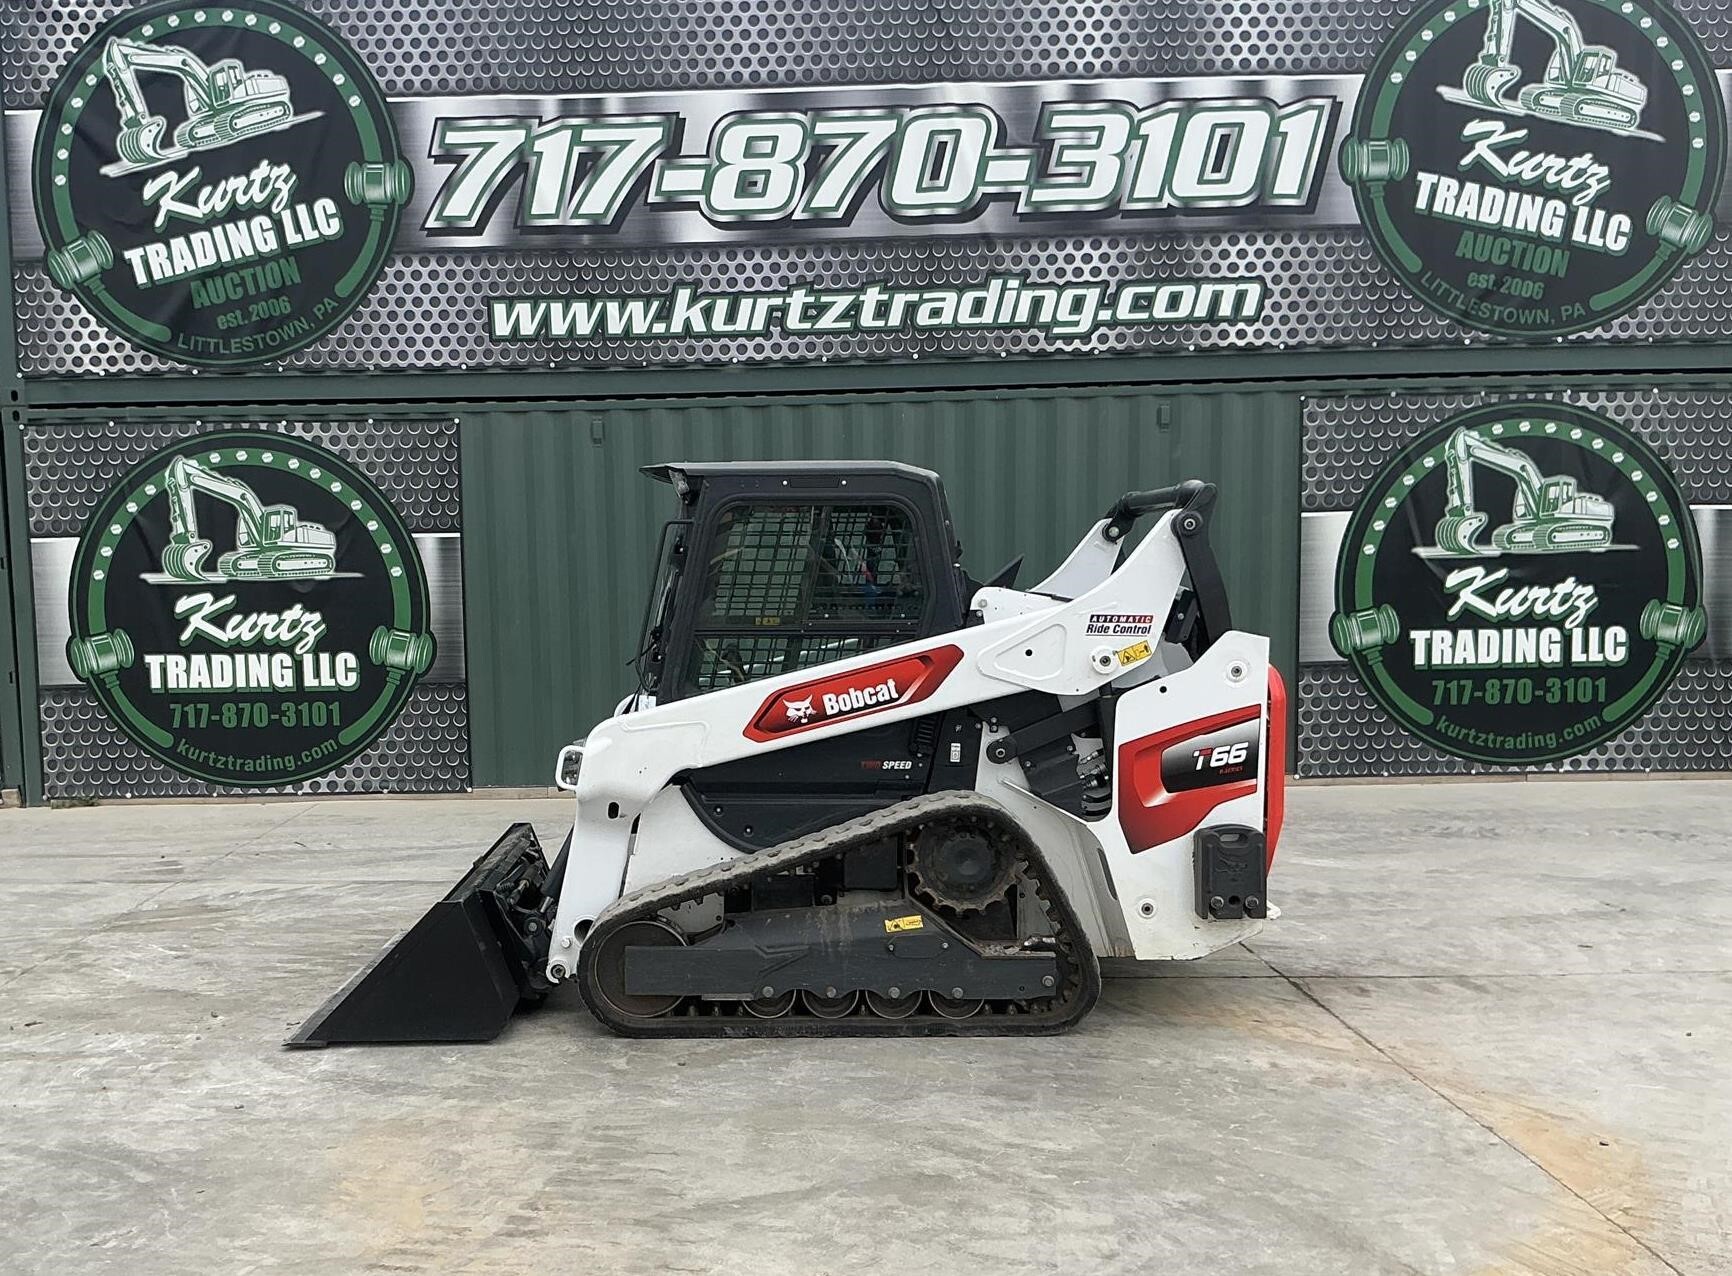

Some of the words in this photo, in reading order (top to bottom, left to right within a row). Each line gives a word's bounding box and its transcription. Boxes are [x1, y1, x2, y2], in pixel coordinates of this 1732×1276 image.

[428, 100, 1332, 230] 717-870-3101
[1458, 120, 1610, 204] Kurtz
[143, 160, 297, 230] Kurtz
[1415, 172, 1568, 240] TRADING
[1572, 206, 1633, 253] LLC
[124, 216, 275, 287] TRADING
[281, 198, 342, 246] LLC
[1455, 231, 1570, 278] AUCTION
[190, 257, 301, 309] AUCTION
[1420, 271, 1556, 325] LITTLESTOWN,
[1561, 303, 1586, 320] PA
[1467, 271, 1496, 289] est.
[1500, 276, 1545, 300] 2006
[177, 318, 315, 354] LITTLESTOWN,
[313, 297, 339, 320] PA
[217, 312, 243, 330] est.
[248, 297, 292, 325] 2006
[489, 276, 1265, 338] www.kurtztrading.com
[1445, 566, 1598, 629] Kurtz
[175, 592, 327, 655] Kurtz
[1086, 624, 1110, 634] Ride
[1113, 624, 1152, 635] Control
[1091, 615, 1152, 623] AUTOMATIC
[1410, 628, 1562, 667] TRADING
[1571, 626, 1628, 665] LLC
[144, 653, 294, 691] TRADING
[302, 652, 360, 690] LLC
[1431, 677, 1606, 705] 717-870-3101
[169, 701, 341, 729] 717-870-3101
[822, 678, 899, 716] Bobcat
[1436, 715, 1602, 750] kurtztrading.com
[176, 735, 339, 772] kurtztrading.com
[882, 761, 912, 769] SPEED
[1193, 742, 1249, 771] T66
